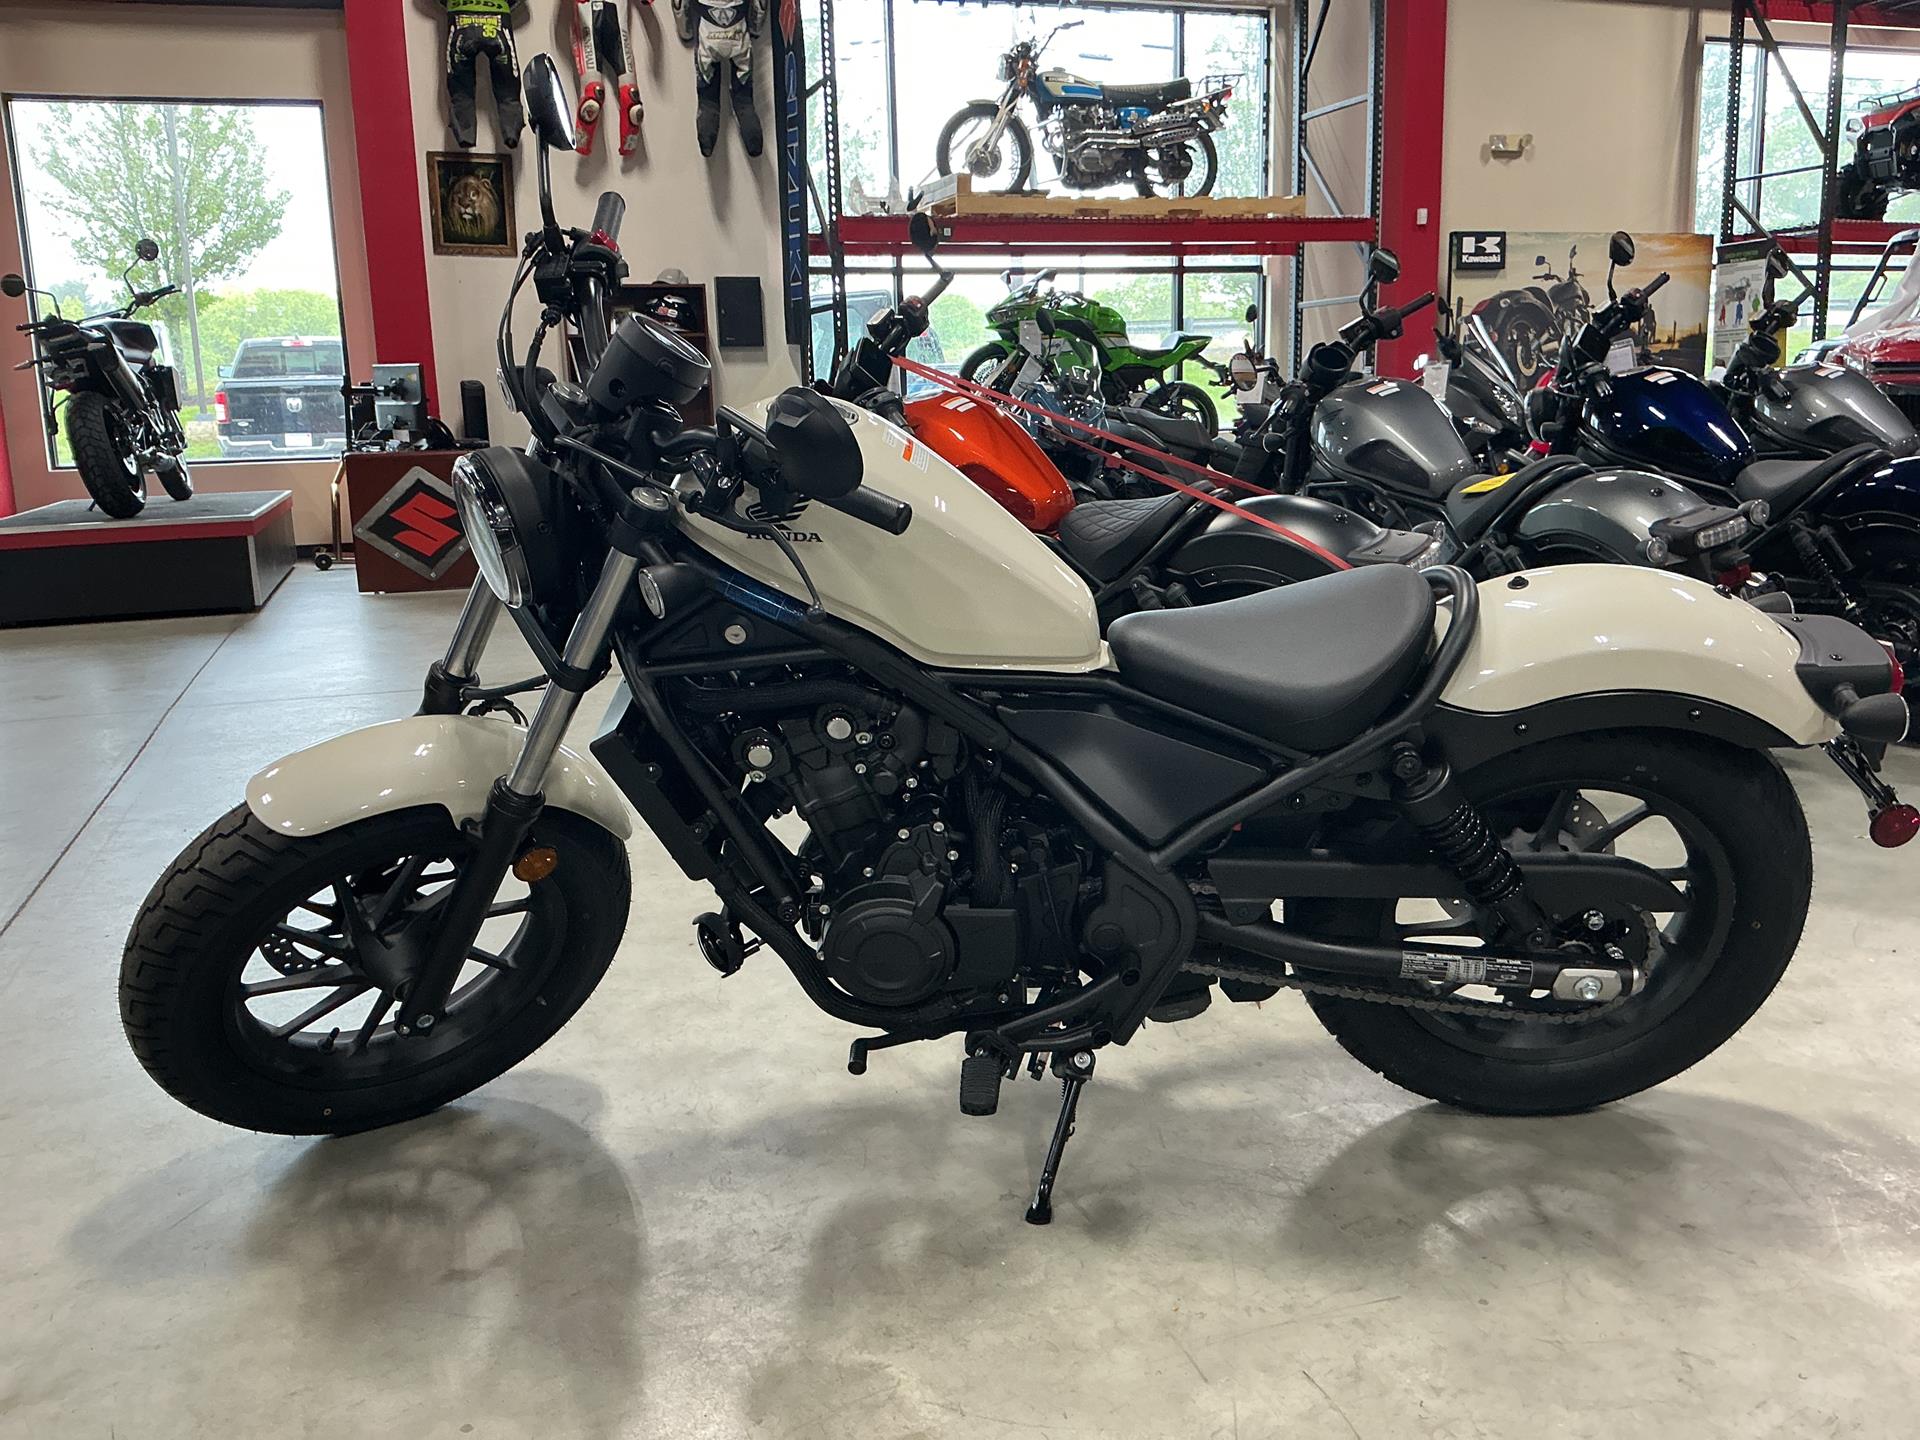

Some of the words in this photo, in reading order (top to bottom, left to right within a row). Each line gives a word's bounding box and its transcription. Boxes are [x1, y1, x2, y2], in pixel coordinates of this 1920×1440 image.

[482, 25, 497, 39] 35
[784, 50, 803, 301] SUZUKI
[1461, 254, 1502, 264] Kawasaki
